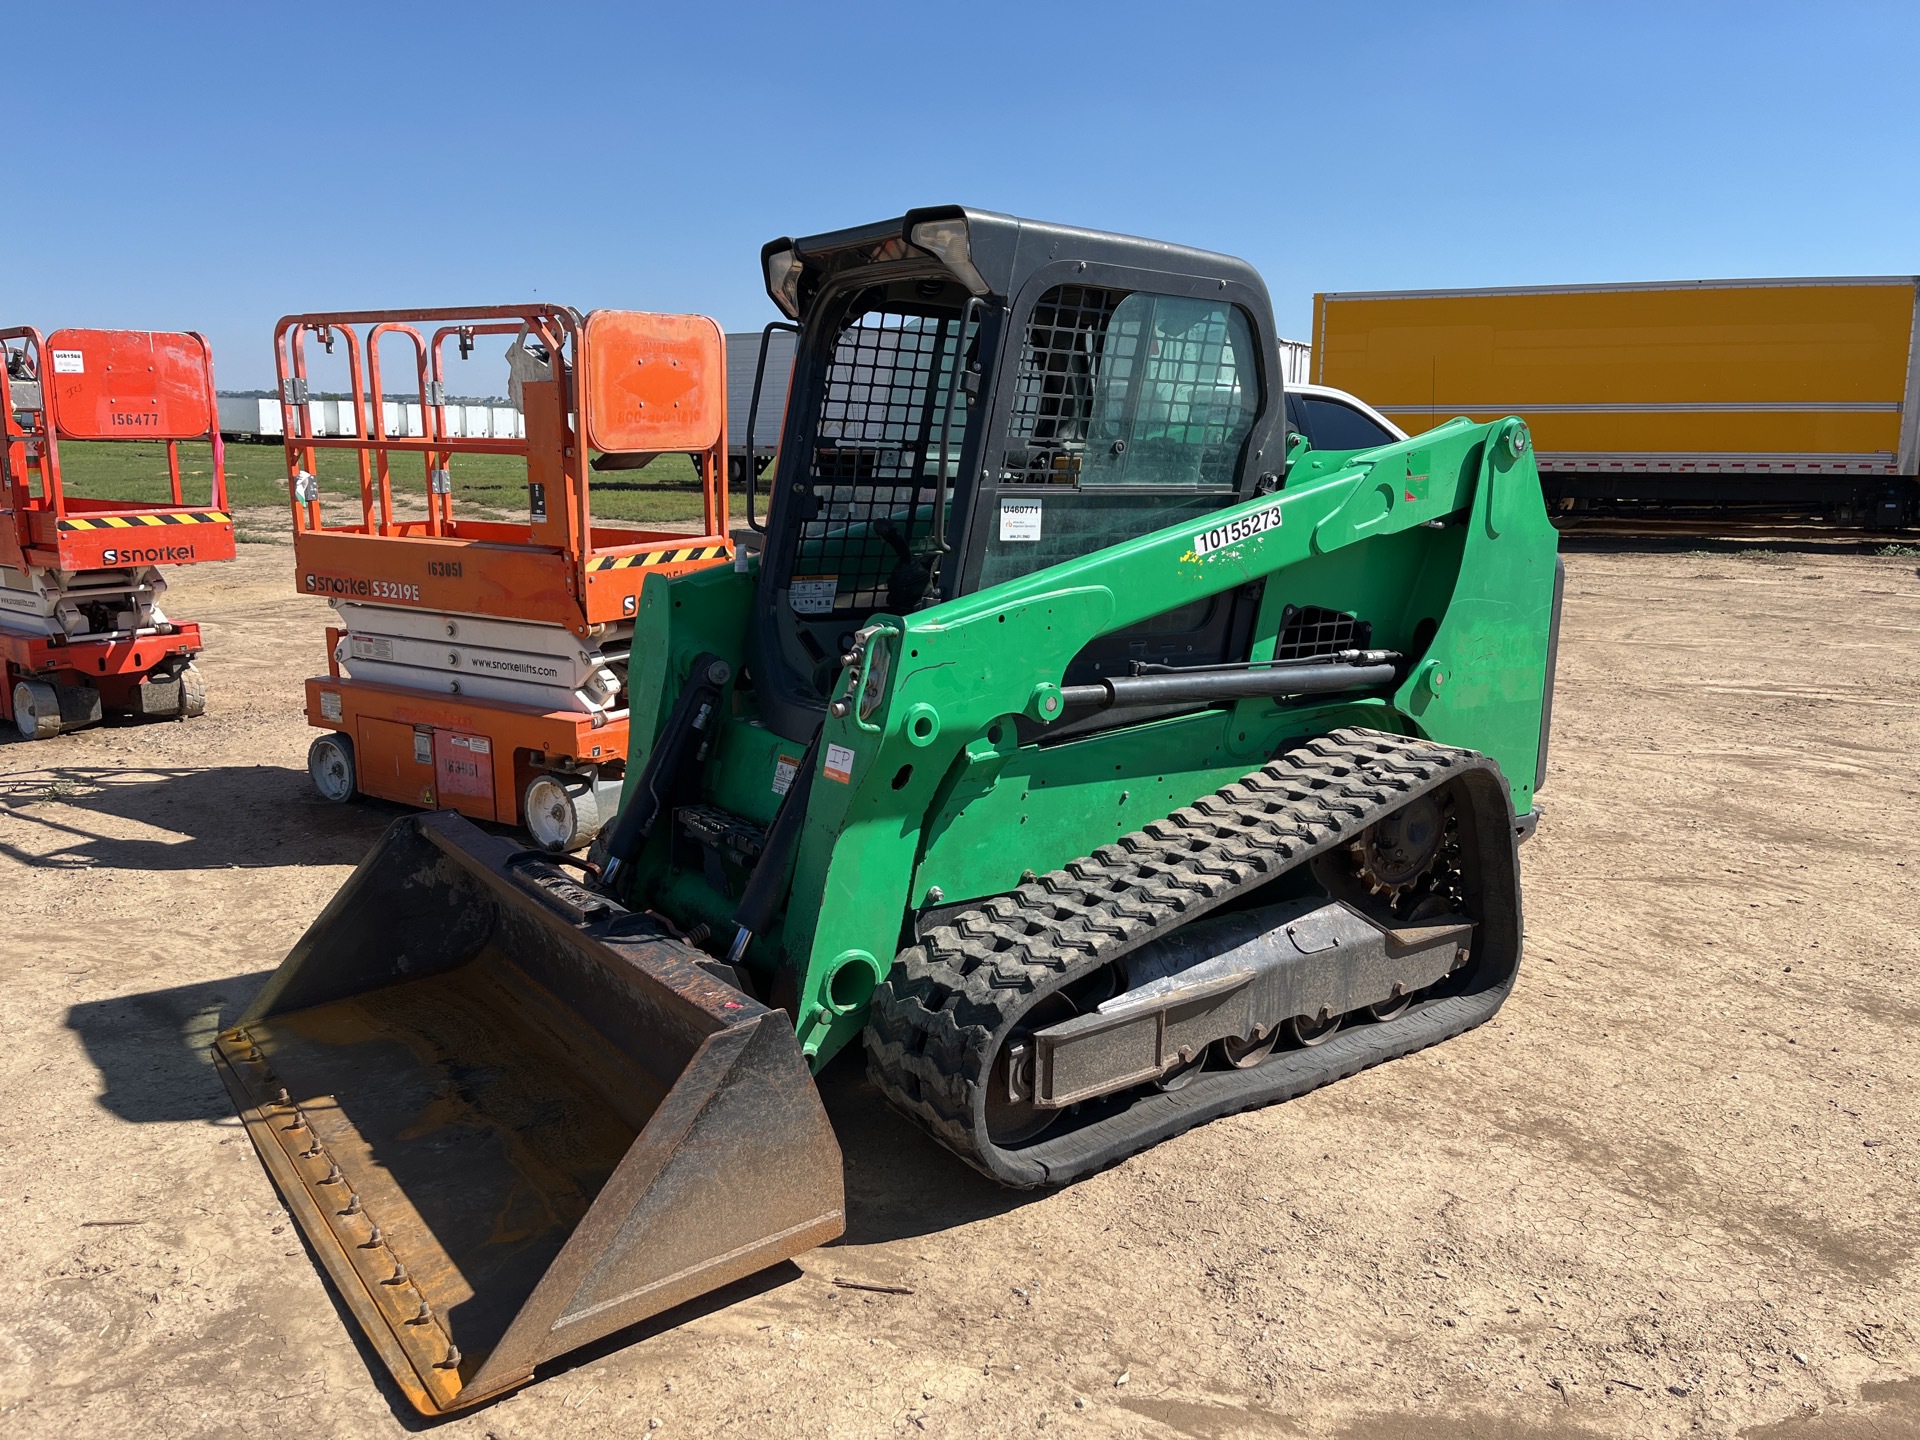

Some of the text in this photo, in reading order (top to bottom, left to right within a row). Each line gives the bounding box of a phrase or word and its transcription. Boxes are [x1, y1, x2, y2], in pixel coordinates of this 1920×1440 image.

[112, 414, 158, 426] 156477
[1004, 506, 1038, 514] U460771
[1200, 507, 1280, 551] 10155273
[120, 545, 194, 562] snorkel
[428, 560, 462, 577] 163051
[318, 576, 372, 596] snorkel
[372, 580, 420, 601] S3219E
[472, 658, 558, 678] www.snorkellifts.com
[828, 748, 850, 766] IP
